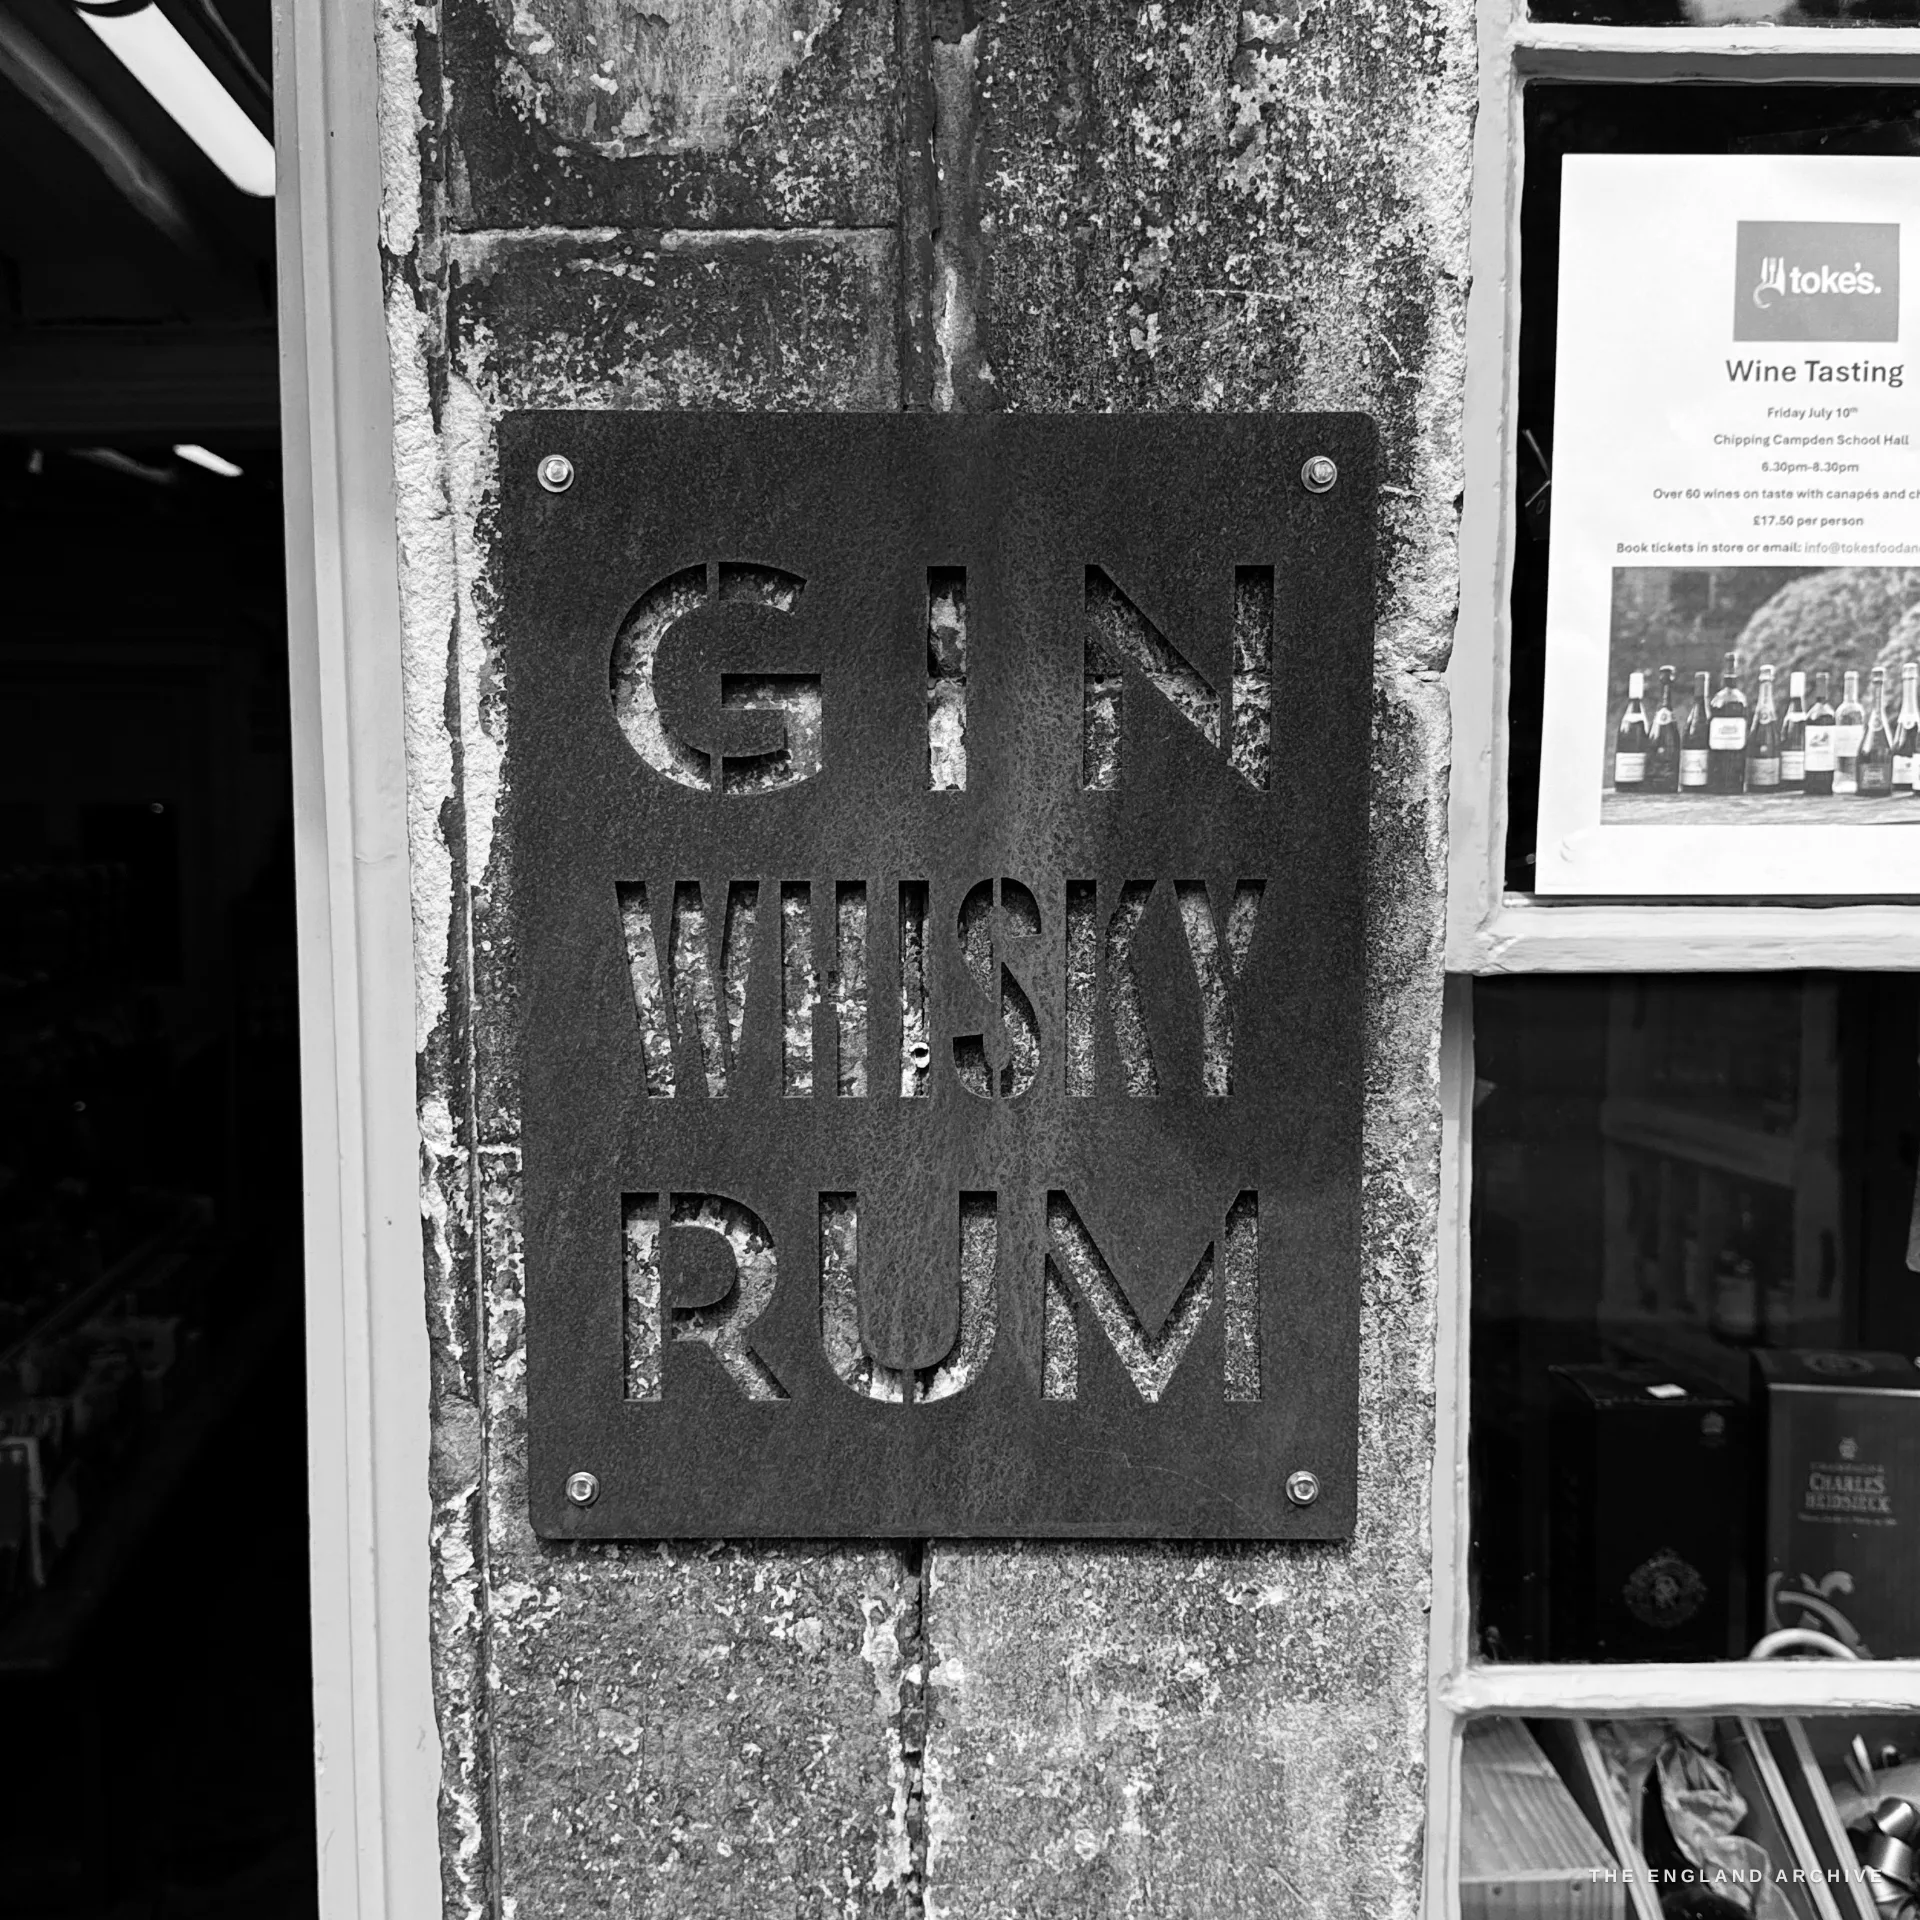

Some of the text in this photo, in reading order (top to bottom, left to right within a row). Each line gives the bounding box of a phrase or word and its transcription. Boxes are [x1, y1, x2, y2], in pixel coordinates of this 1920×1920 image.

[1726, 359, 1905, 388] Wine Tasting
[1767, 406, 1806, 421] Friday
[1808, 407, 1834, 421] July
[1713, 433, 1910, 448] Chipping Campden School Hall
[1652, 487, 1684, 500] Over
[1685, 488, 1701, 500] 60
[1703, 488, 1741, 500] wines
[1743, 490, 1760, 500] on
[1762, 489, 1794, 500] taste
[1797, 488, 1824, 499] with
[1826, 488, 1880, 502] canapés
[1882, 489, 1906, 500] and
[1752, 514, 1865, 528] £17.50 per person
[1616, 541, 1920, 555] Book tickets in store or email: info@tokesfoodan
[609, 562, 1274, 795] GIN
[615, 877, 1267, 1099] WHISKY
[621, 1189, 1262, 1403] RUM
